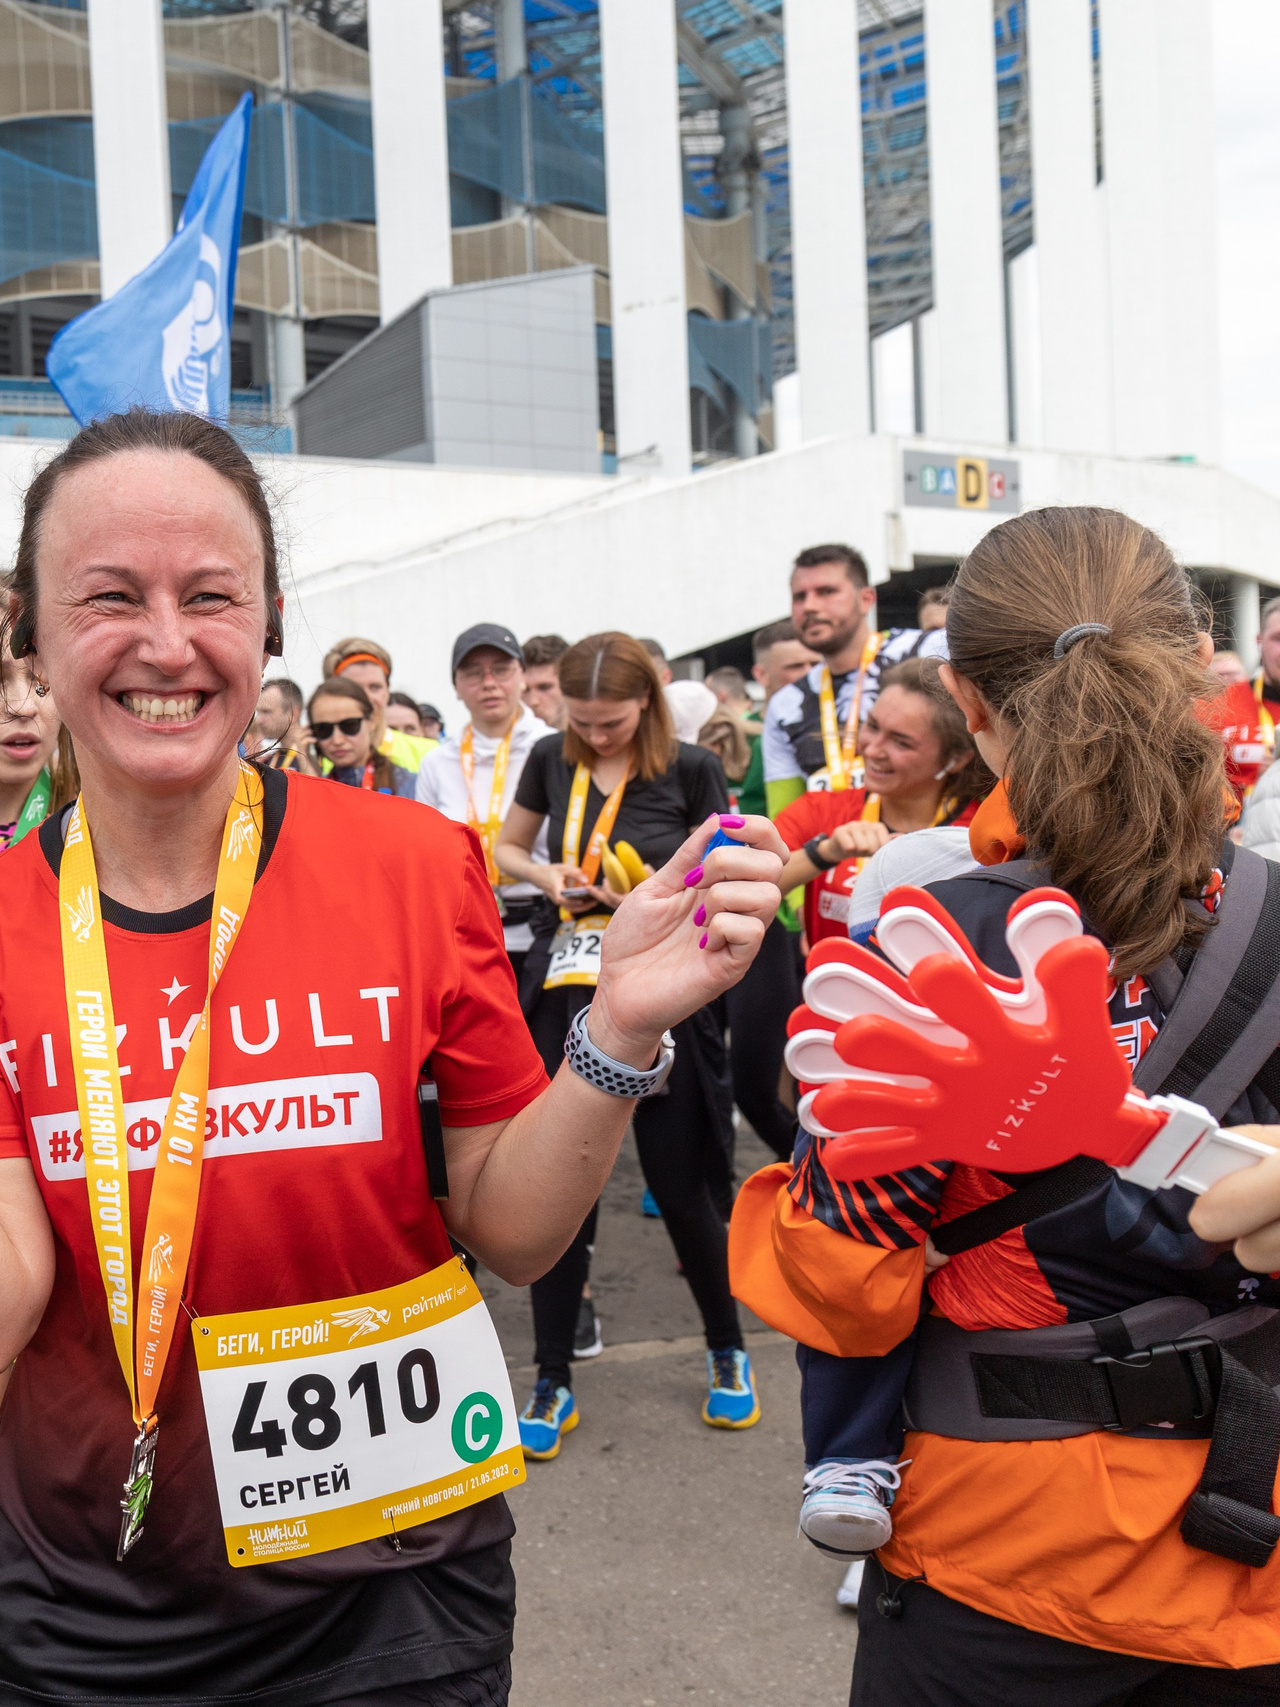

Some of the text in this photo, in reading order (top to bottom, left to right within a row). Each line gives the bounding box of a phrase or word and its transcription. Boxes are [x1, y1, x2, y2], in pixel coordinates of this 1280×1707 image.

[923, 467, 937, 493] B
[941, 467, 956, 493] A
[964, 464, 982, 502] D
[66, 799, 83, 848] РОД
[986, 1053, 1067, 1151] FIZKULT
[167, 1091, 200, 1166] 10 КМ
[76, 990, 128, 1326] ГЕРОИ МЕНЯЮТ ЭТОТ ГОРОД
[402, 1287, 453, 1323] рейтинг
[143, 1285, 168, 1377] БЕГИ, ГЕРОЙ!
[217, 1319, 330, 1357] БЕГИ, ГЕРОЙ!
[231, 1347, 441, 1459] 4810
[464, 1403, 491, 1451] C
[240, 1462, 351, 1509] СЕРГЕЙ
[382, 1496, 421, 1521] НИЖНИЙ
[422, 1482, 465, 1509] НОВГОРОД
[470, 1463, 510, 1490] 21.05.2023
[252, 1539, 299, 1552] МОЛОДЁЖНАЯ
[253, 1542, 310, 1557] СТОЛИЦА РОССИИ
